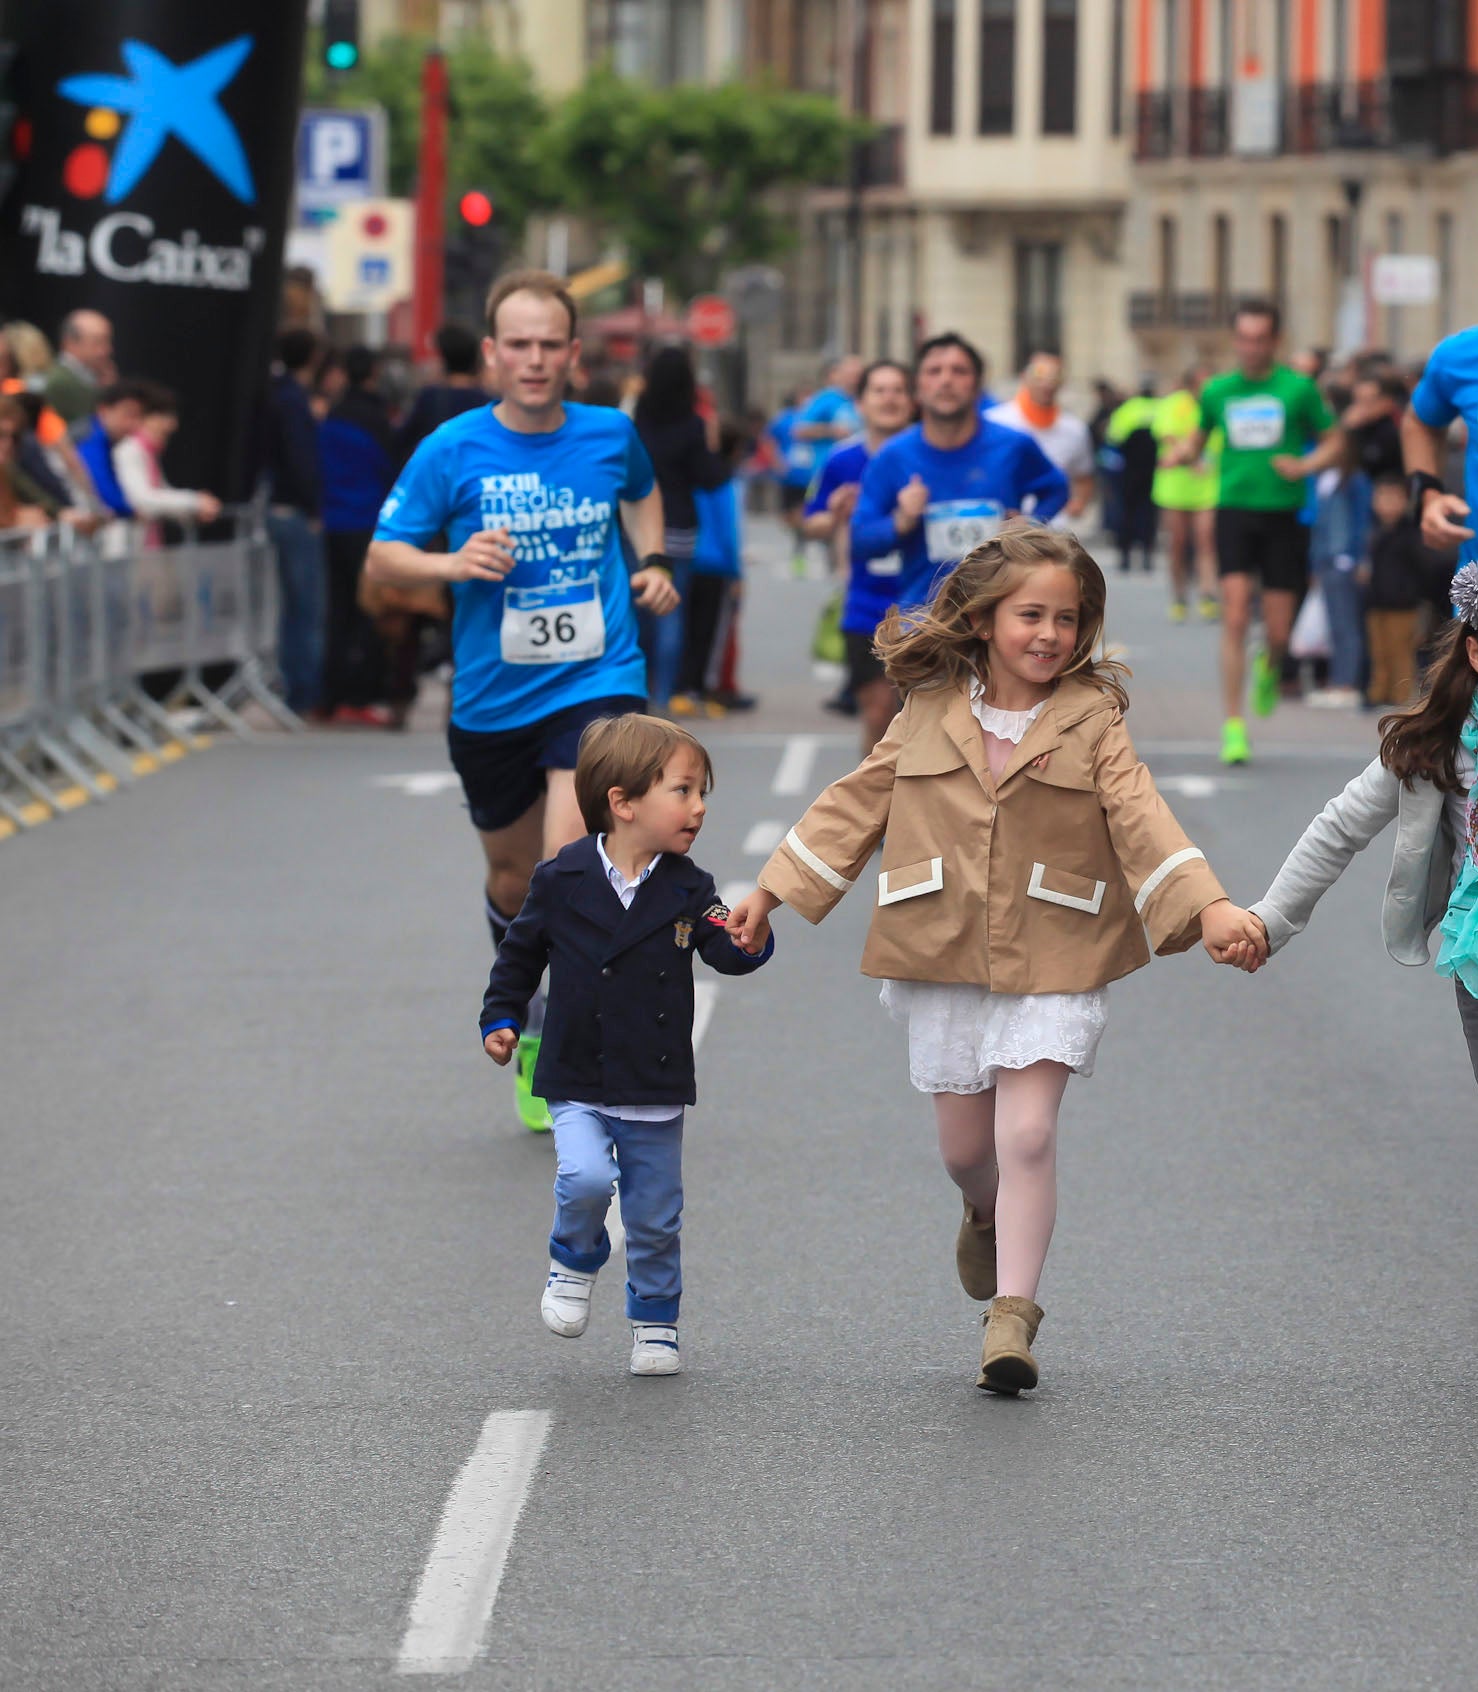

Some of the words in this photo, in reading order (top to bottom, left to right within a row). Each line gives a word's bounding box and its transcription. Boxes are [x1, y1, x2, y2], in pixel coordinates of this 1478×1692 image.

[480, 484, 574, 513] media
[482, 497, 611, 531] maratón
[529, 612, 576, 646] 36
